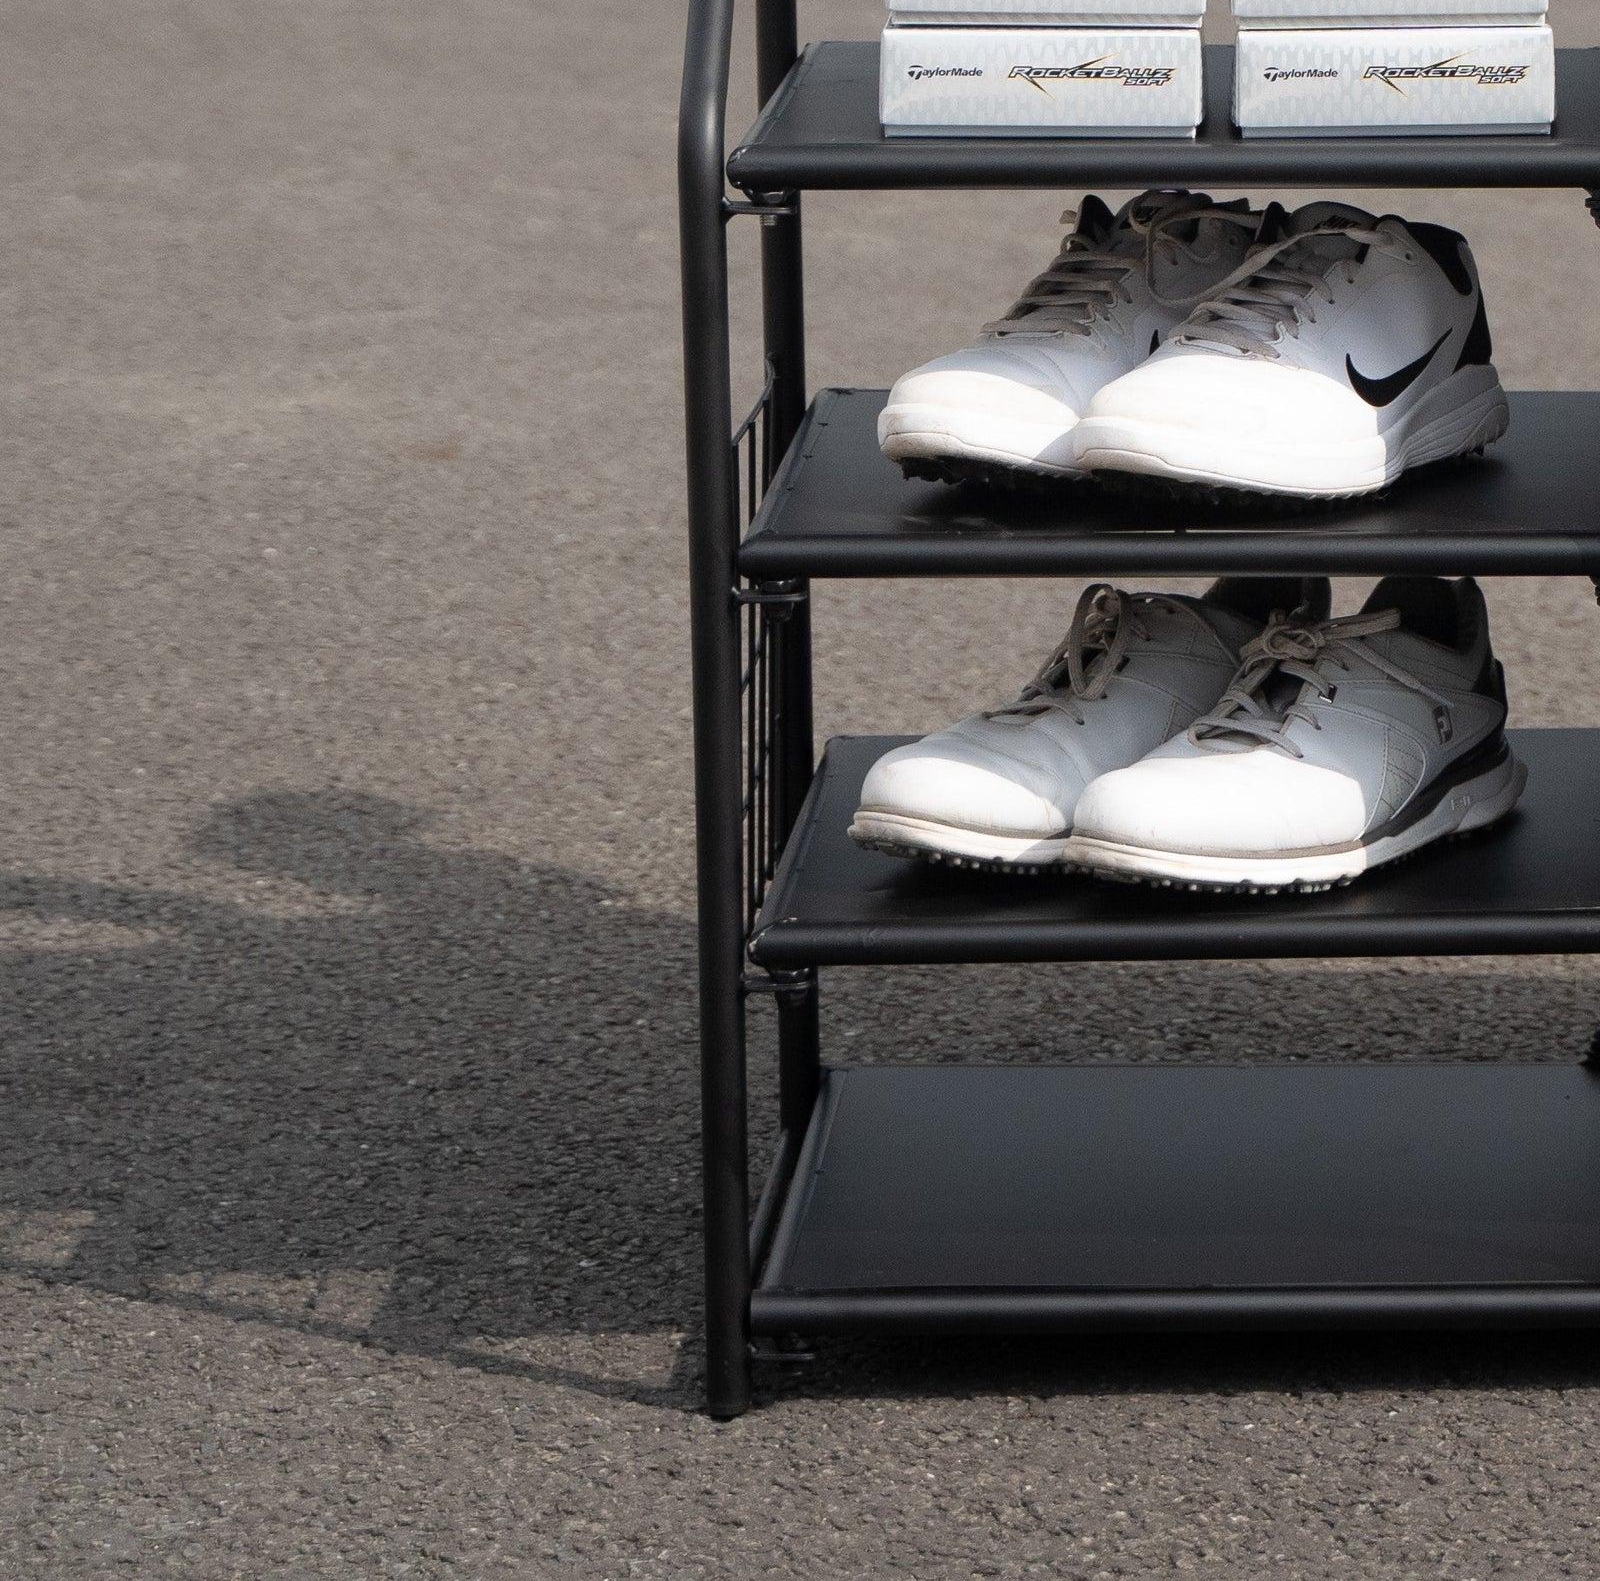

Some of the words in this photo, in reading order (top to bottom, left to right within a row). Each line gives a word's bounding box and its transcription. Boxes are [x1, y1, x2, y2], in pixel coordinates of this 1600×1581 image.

[908, 65, 983, 80] TaylorMade
[1263, 66, 1338, 82] TaylorMade
[1123, 76, 1170, 86] SOFT
[1477, 75, 1524, 85] SOFT
